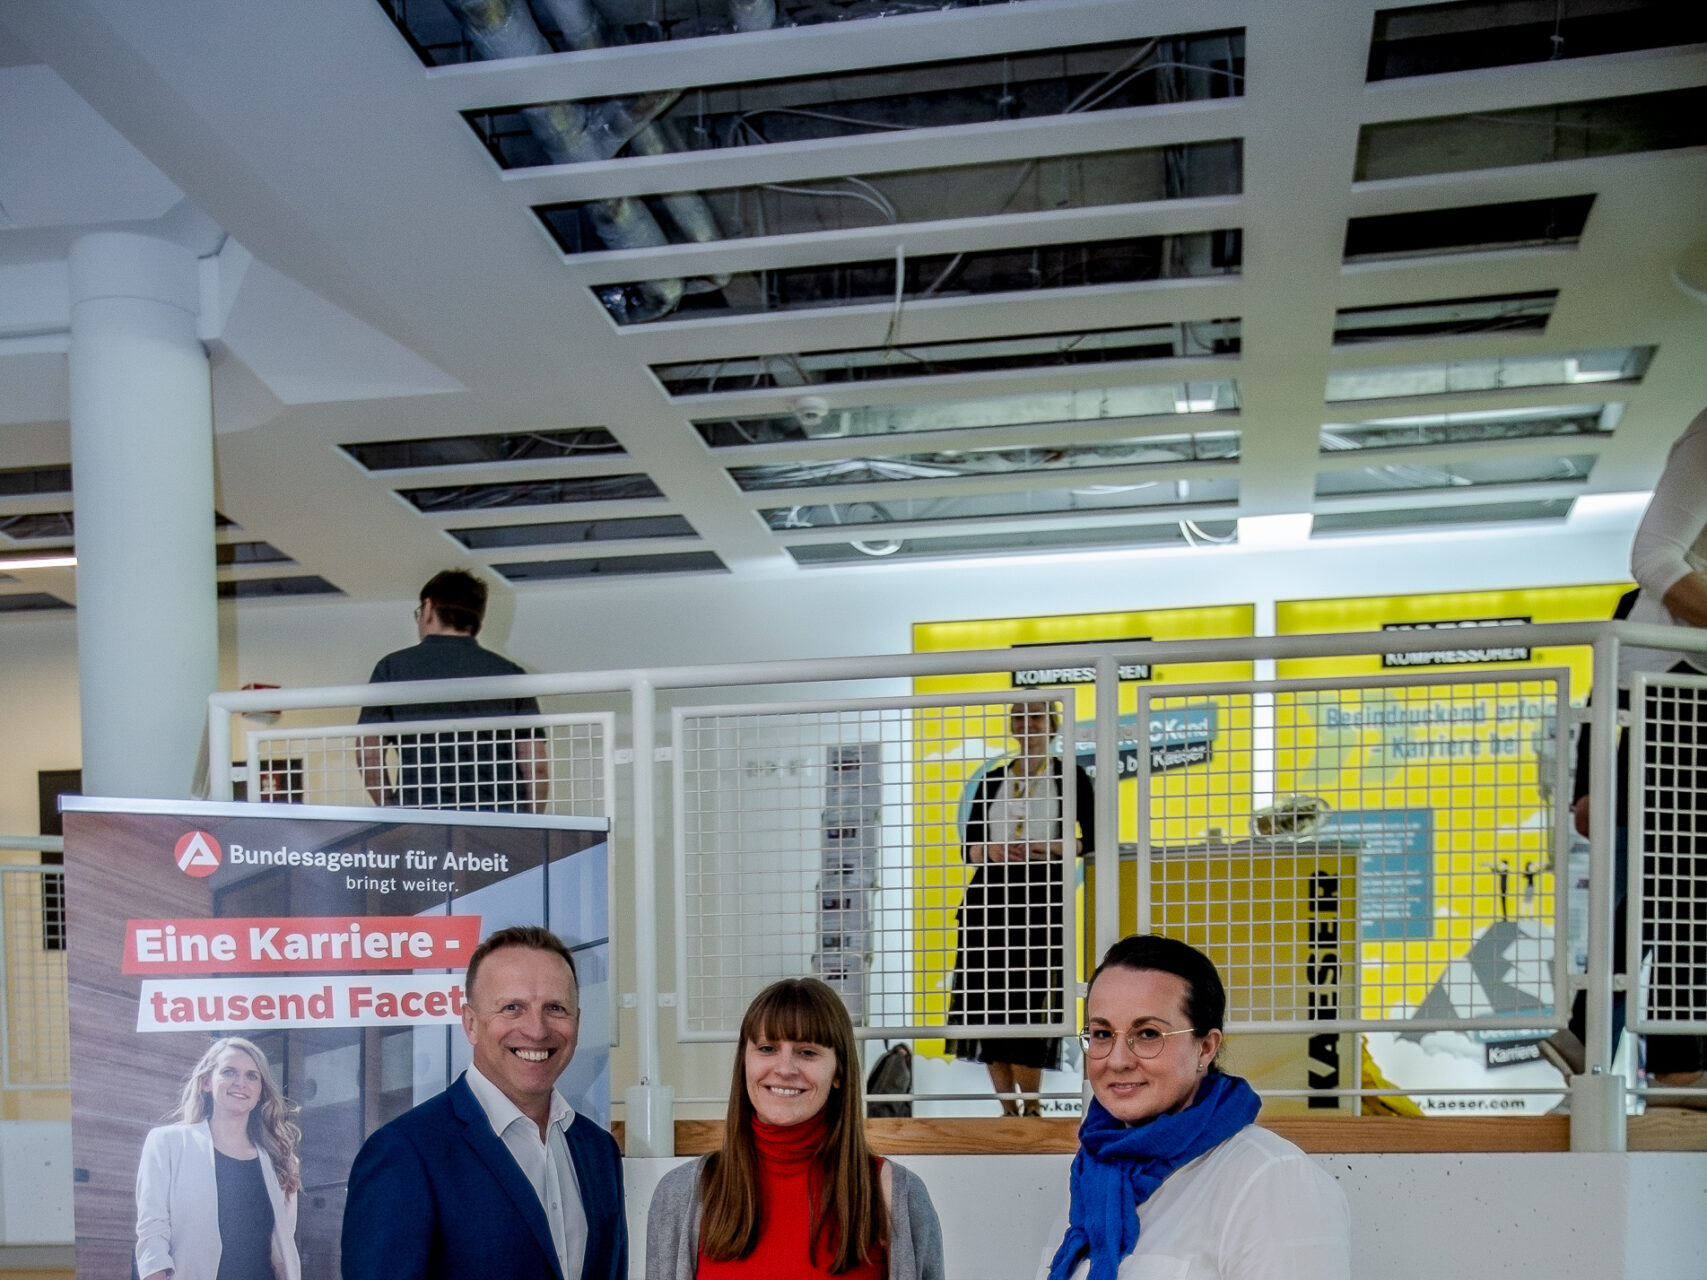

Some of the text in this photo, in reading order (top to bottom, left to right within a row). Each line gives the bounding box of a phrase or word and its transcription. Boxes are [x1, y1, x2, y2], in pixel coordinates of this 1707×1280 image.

[1392, 735, 1480, 757] Karriere
[230, 845, 509, 872] Bundesagentur für Arbeit
[346, 876, 459, 893] bringt weiter.
[136, 925, 237, 963] Eine
[250, 922, 434, 961] Karriere
[150, 985, 465, 1024] tausend Facet
[1307, 873, 1341, 1108] KAESER
